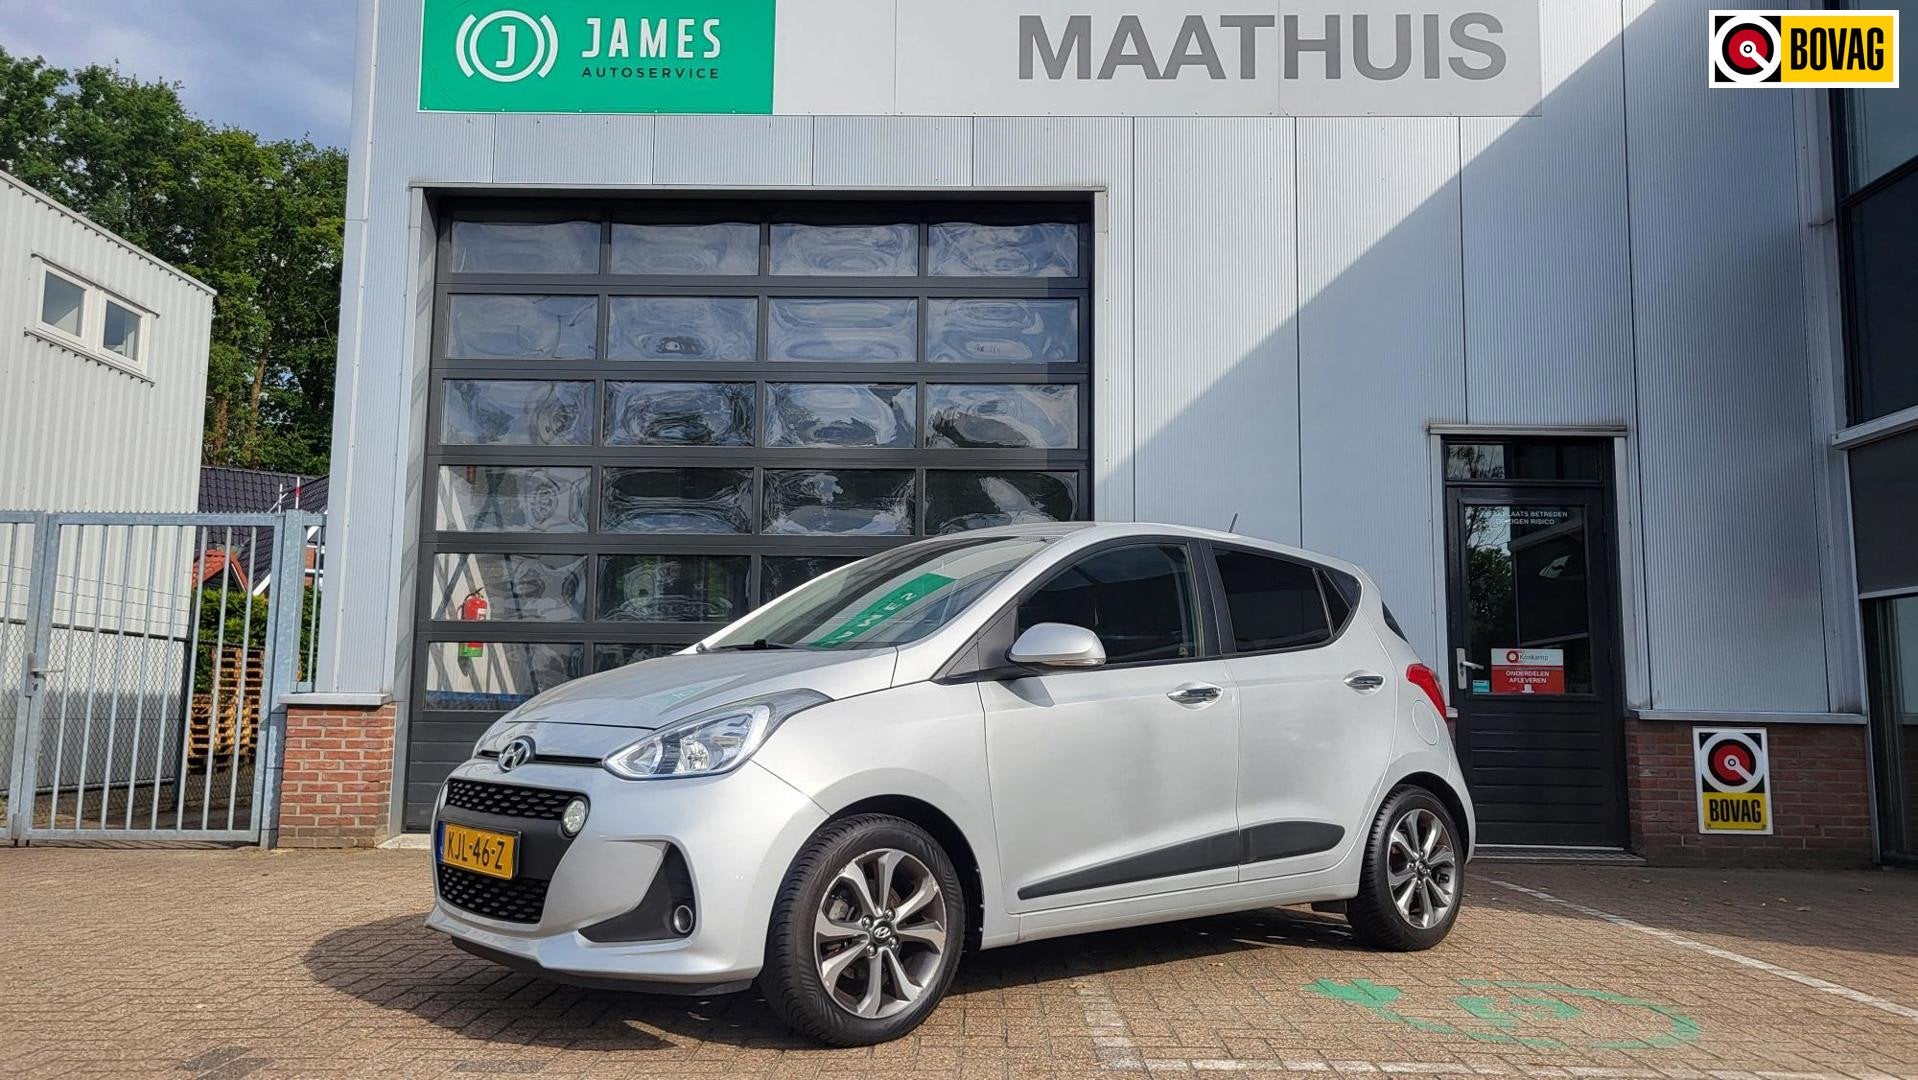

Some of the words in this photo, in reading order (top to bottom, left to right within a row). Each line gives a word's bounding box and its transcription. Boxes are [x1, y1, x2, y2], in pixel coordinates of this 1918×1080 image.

[581, 17, 722, 59] JAMES
[1018, 12, 1507, 81] MAATHUIS
[582, 67, 719, 79] AUTOSERVICE
[1709, 799, 1762, 823] BOVAG
[447, 831, 505, 870] KJL-46-Z
